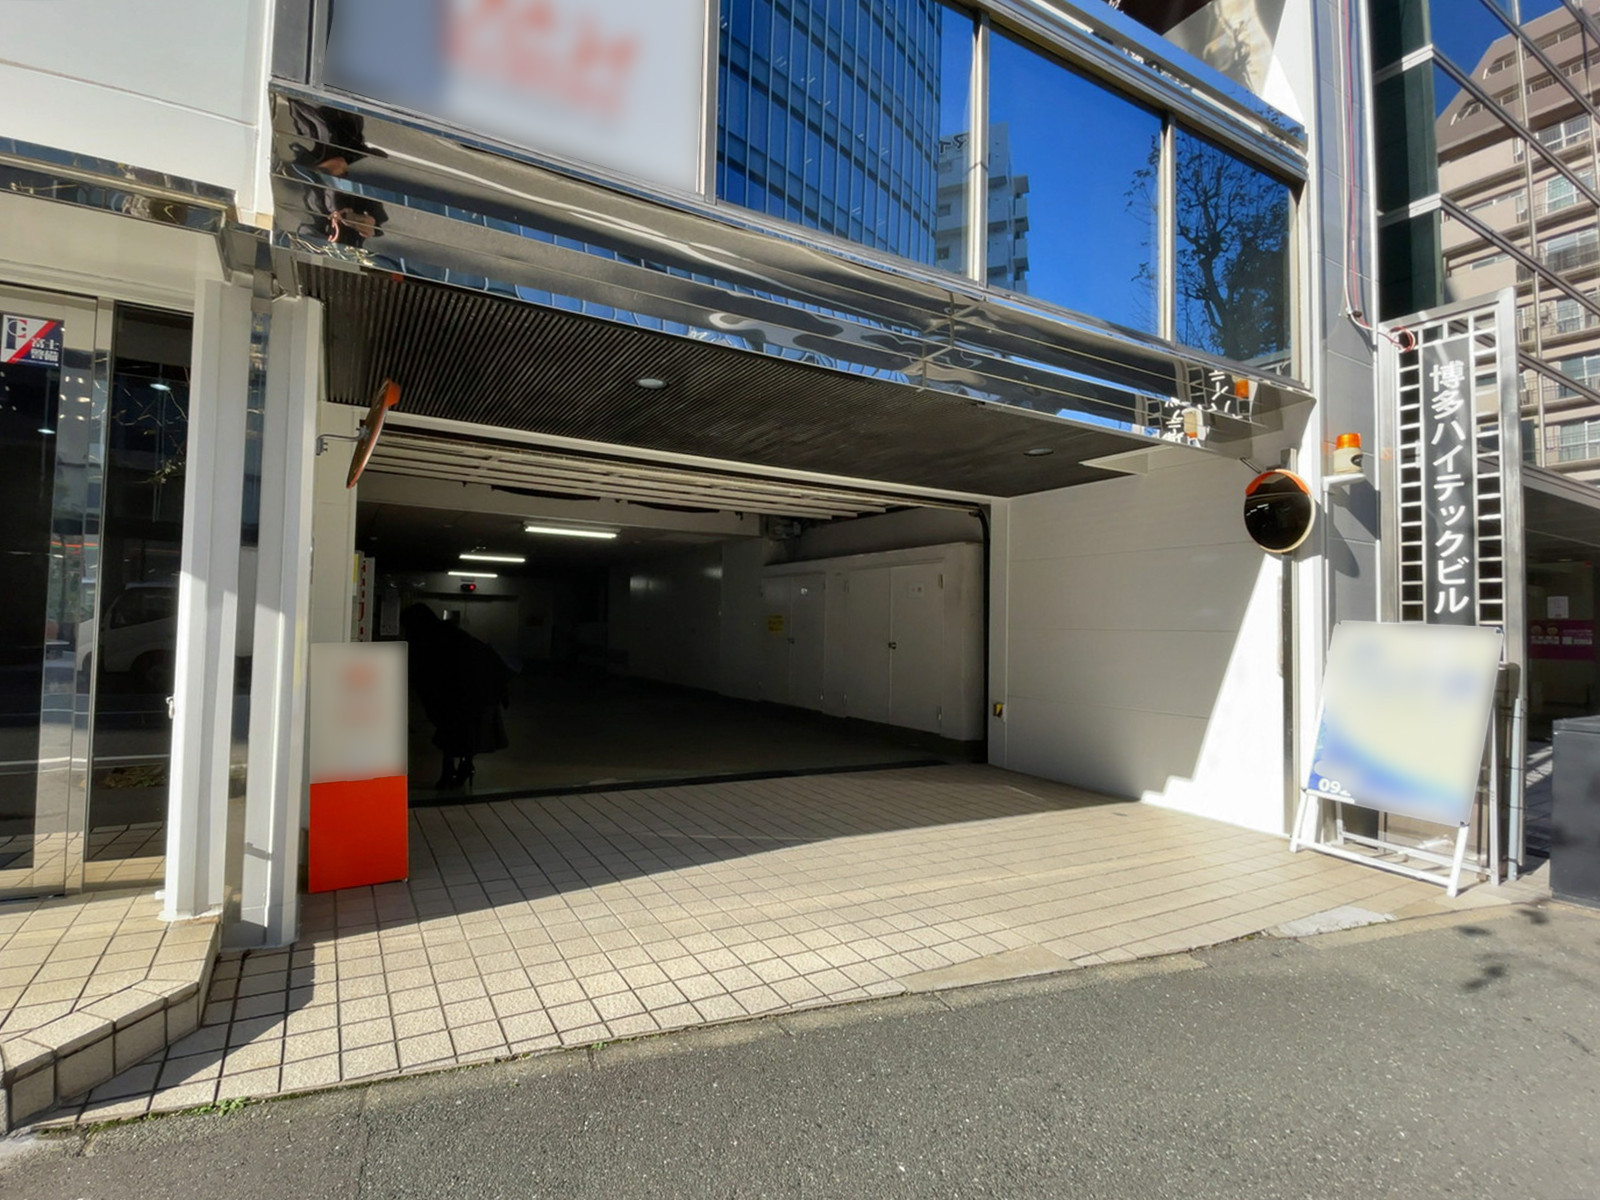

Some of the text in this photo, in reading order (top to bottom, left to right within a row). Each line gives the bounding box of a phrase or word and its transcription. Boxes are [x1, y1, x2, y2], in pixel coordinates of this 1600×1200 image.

[1429, 360, 1470, 614] 博多ハイテックビル
